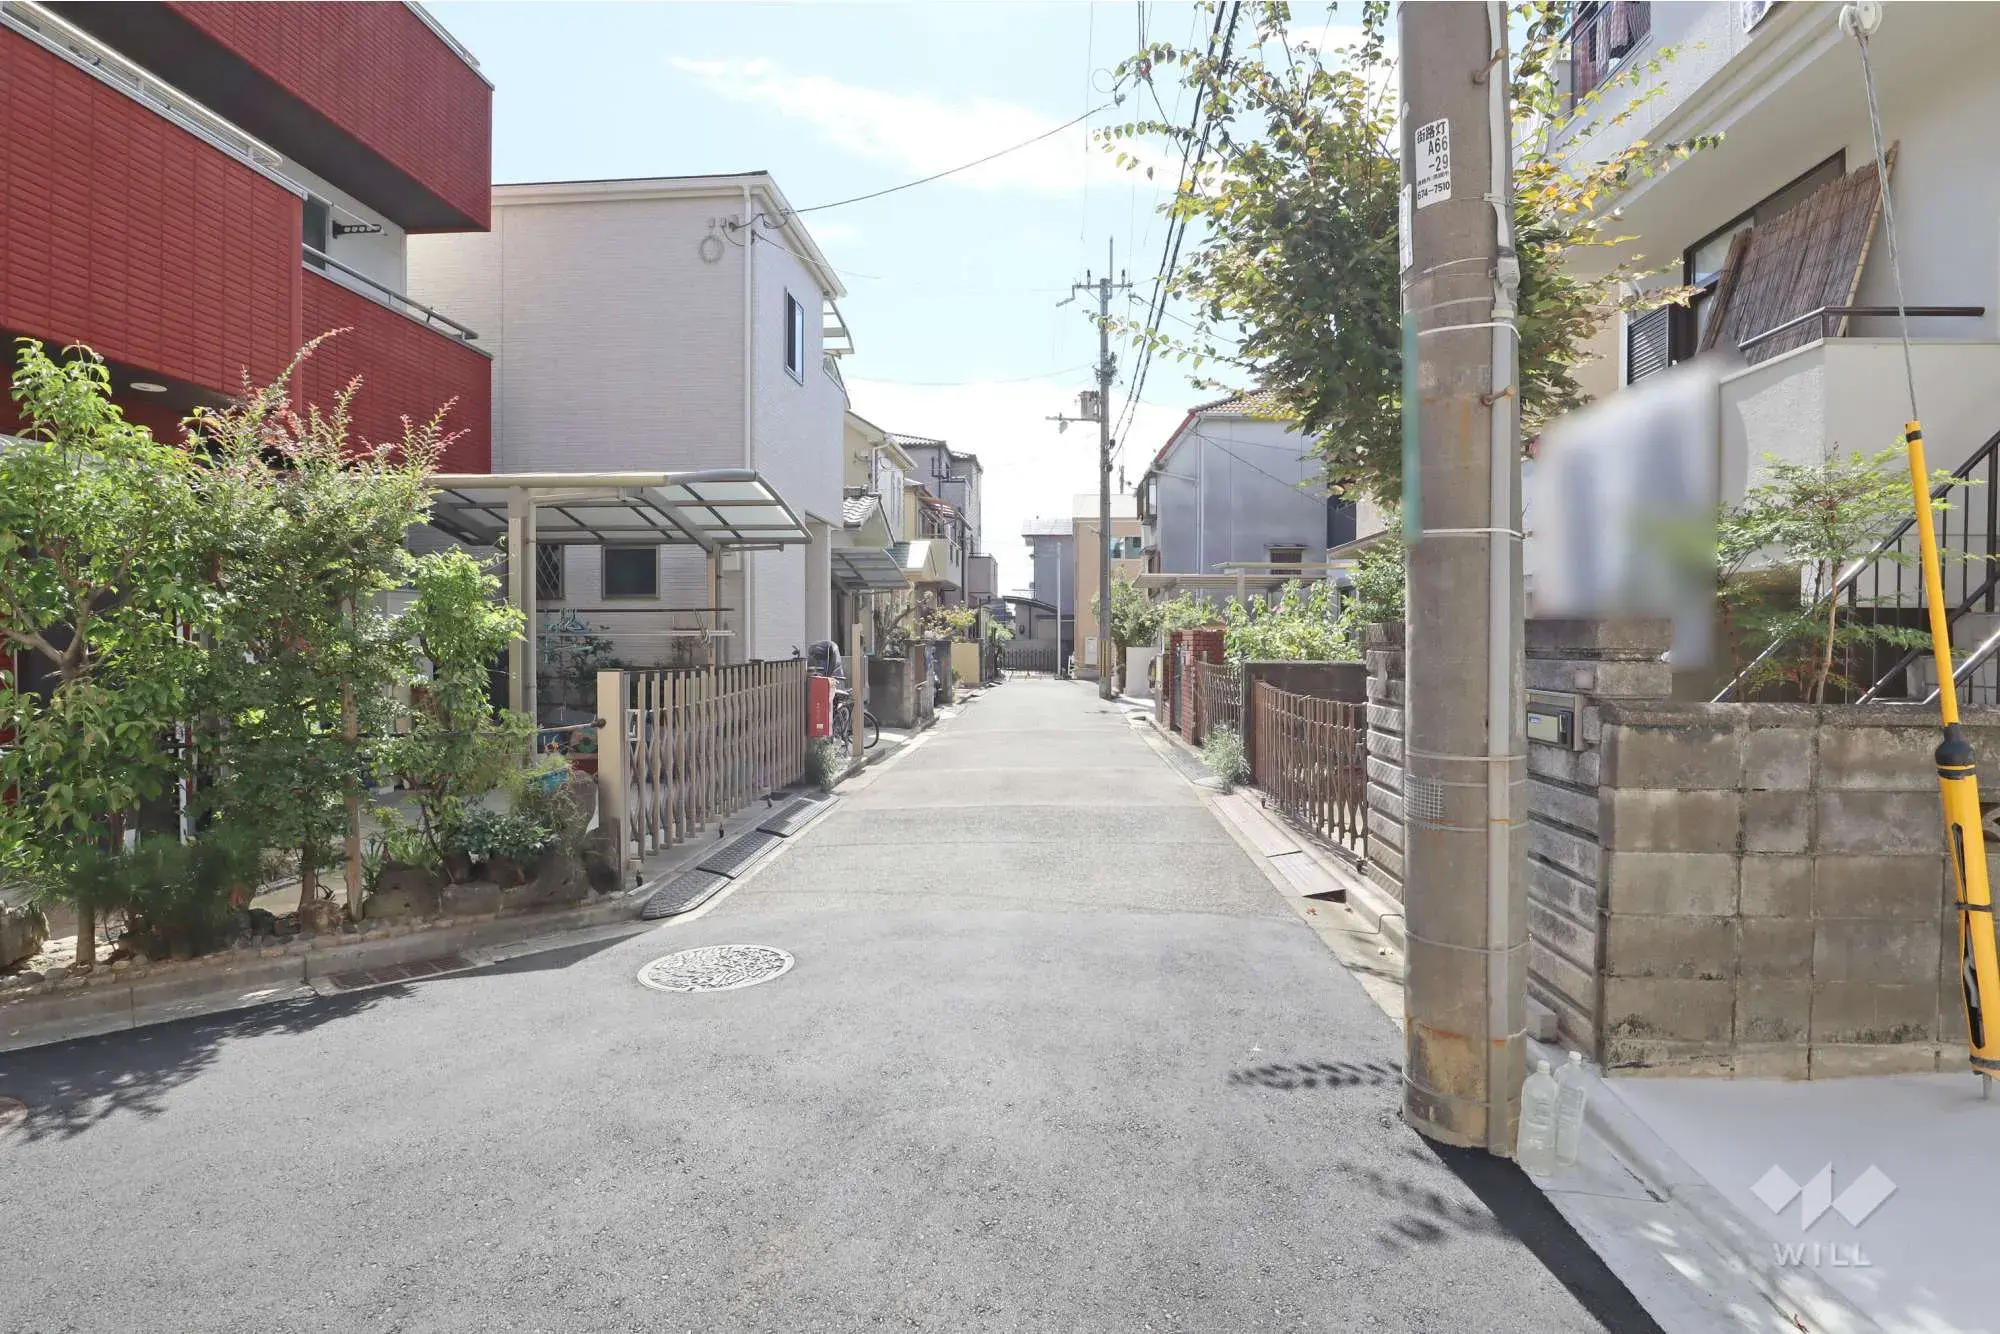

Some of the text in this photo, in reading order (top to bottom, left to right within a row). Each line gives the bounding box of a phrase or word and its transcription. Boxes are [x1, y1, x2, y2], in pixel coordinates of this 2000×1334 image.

[1417, 121, 1446, 144] 街路灯
[1428, 135, 1448, 156] A66
[1428, 153, 1449, 172] -29
